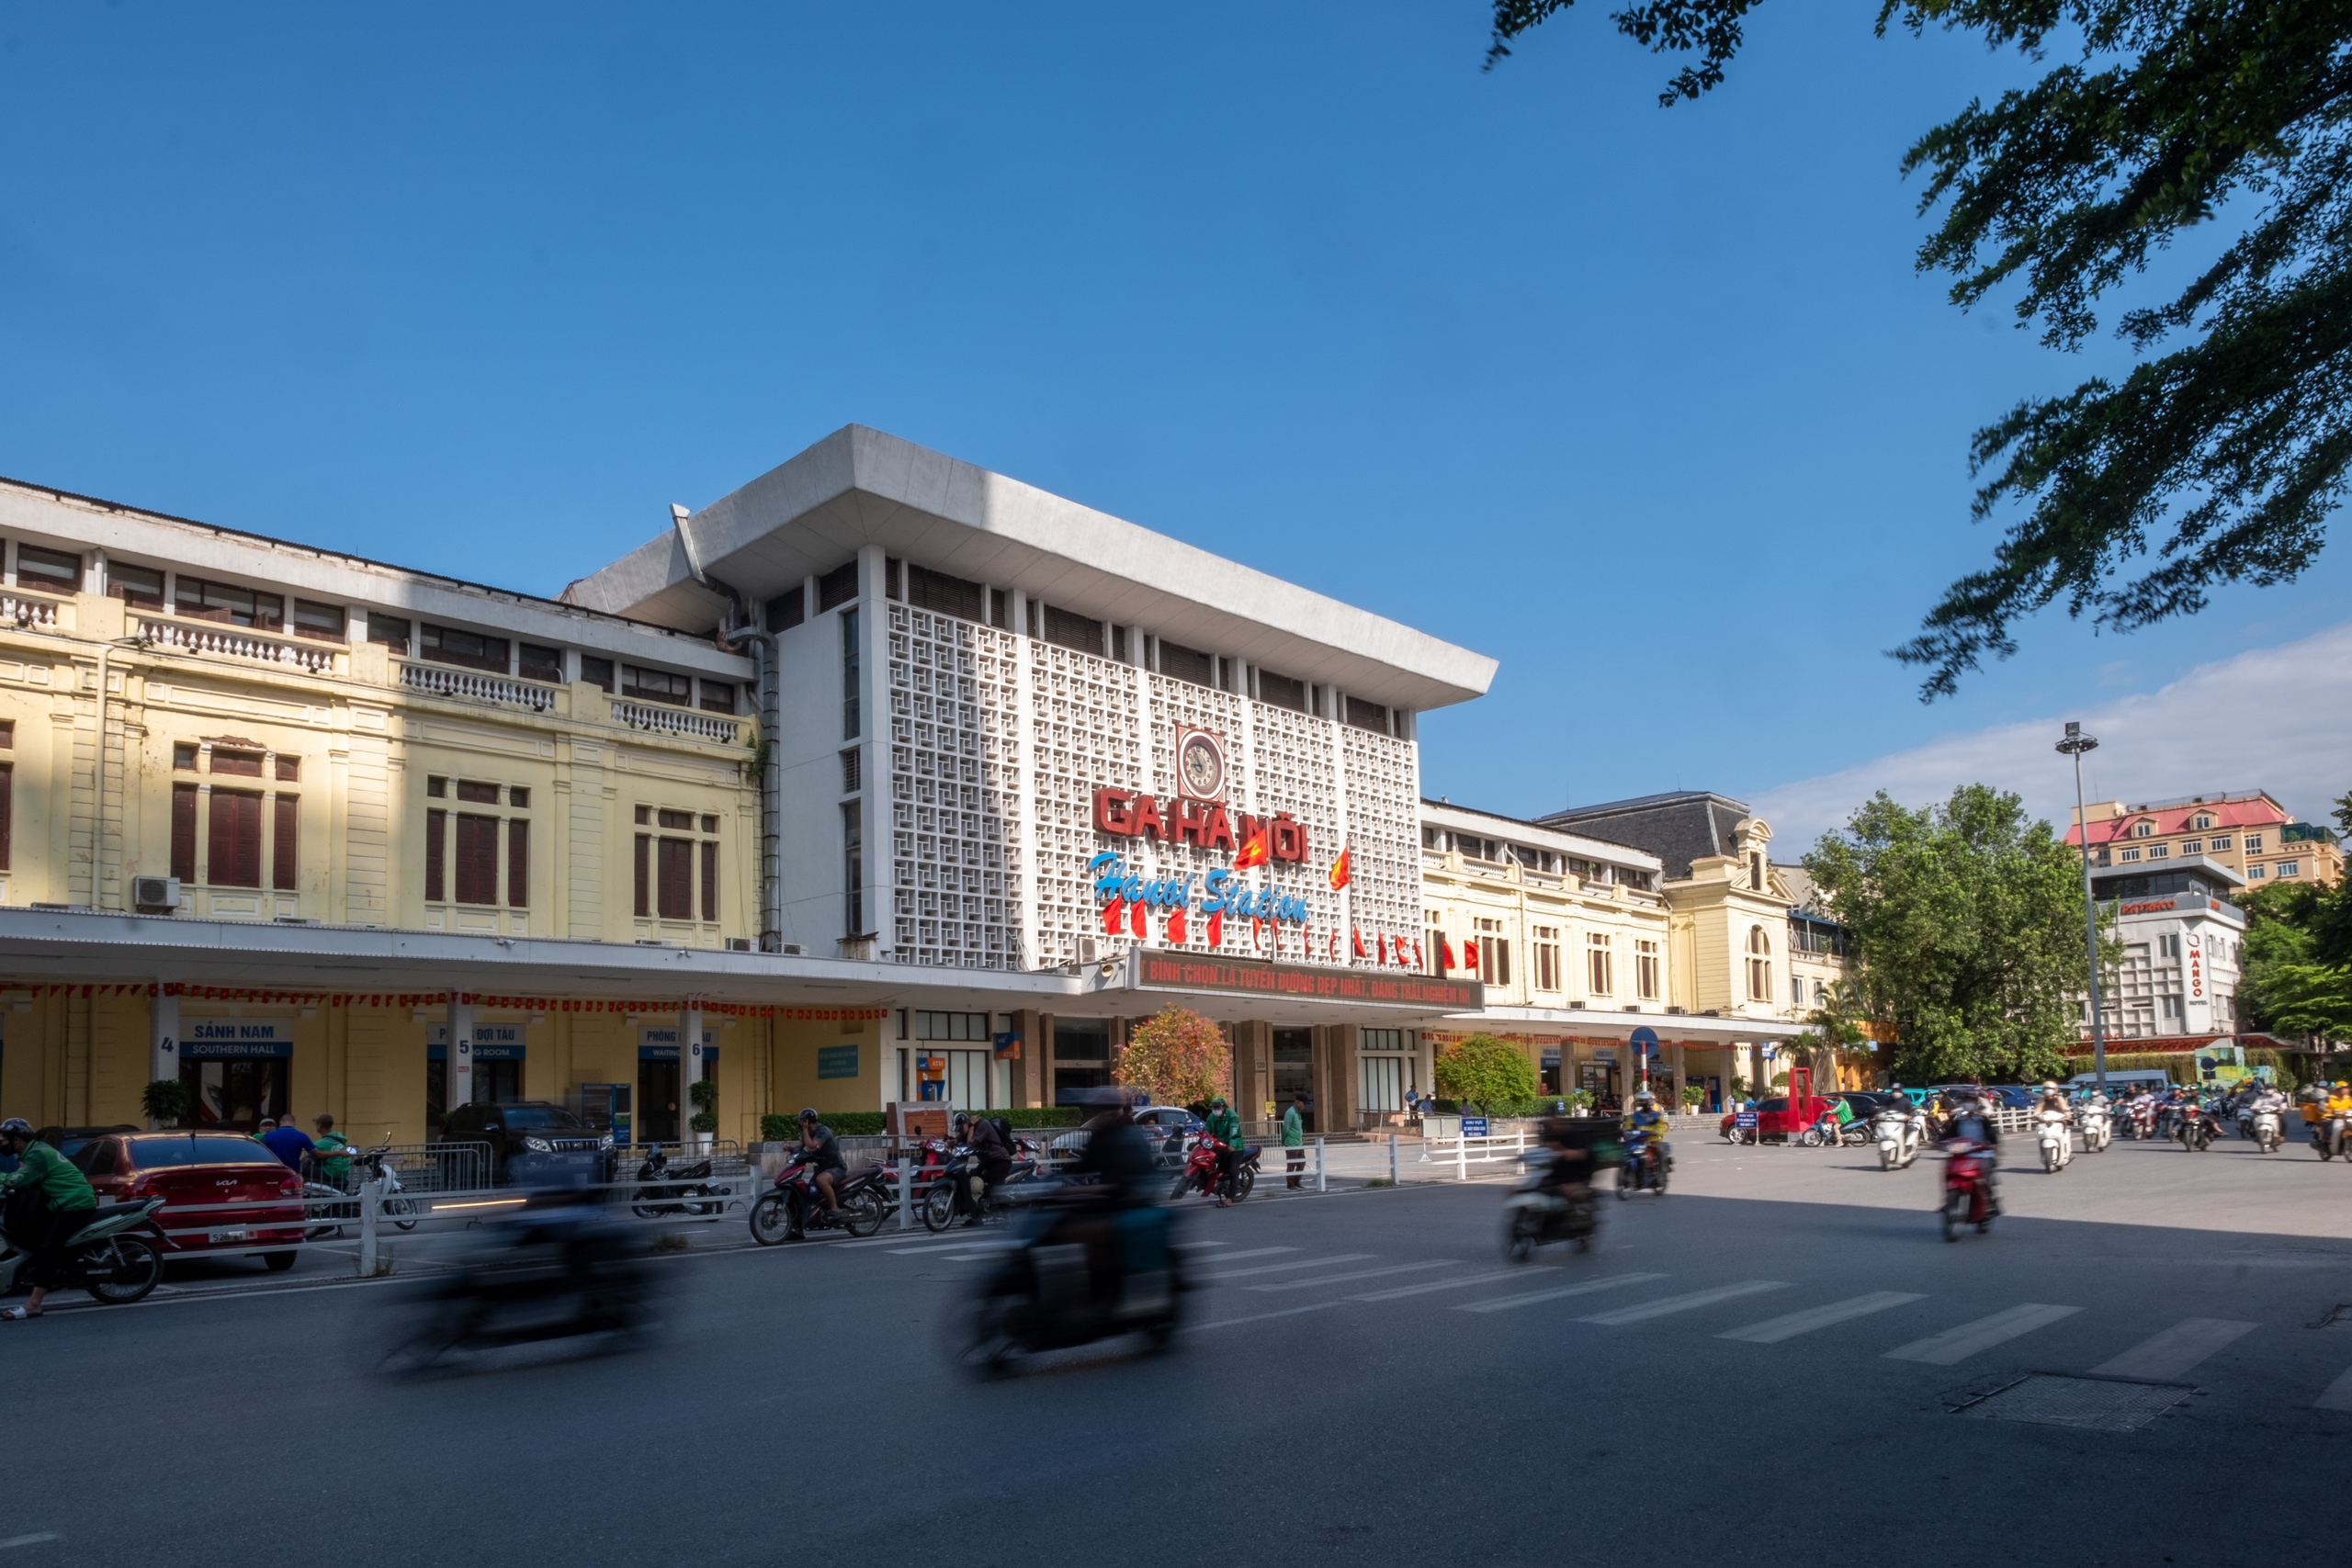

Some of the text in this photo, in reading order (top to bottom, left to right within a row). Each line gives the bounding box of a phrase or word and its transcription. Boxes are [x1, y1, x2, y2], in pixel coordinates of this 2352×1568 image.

[1093, 787, 1166, 840] GA
[1167, 801, 1237, 851] HÀ
[1088, 852, 1309, 923] Hanoi Station
[2121, 900, 2176, 914] RATRACO
[1150, 957, 1181, 982] BÌNH
[1184, 964, 1218, 988] CHỌN
[1221, 964, 1236, 986] LÀ
[1239, 965, 1275, 989] TUYẾN
[1278, 970, 1315, 993] ĐƯỜNG
[1317, 976, 1337, 998] ĐẸP
[1340, 974, 1369, 998] NHẤT,
[1372, 978, 1397, 999] ĐÁNG
[1424, 984, 1457, 1006] NGHIỆM
[2189, 950, 2203, 998] MANGO
[195, 1021, 275, 1039] SẢNH NAM
[477, 1026, 514, 1043] ĐỢI TÀU
[647, 1028, 676, 1042] PHÒNG
[161, 1037, 174, 1053] 4
[192, 1044, 276, 1054] SOUTHERN HALL
[459, 1040, 469, 1054] 5
[692, 1043, 701, 1055] 6
